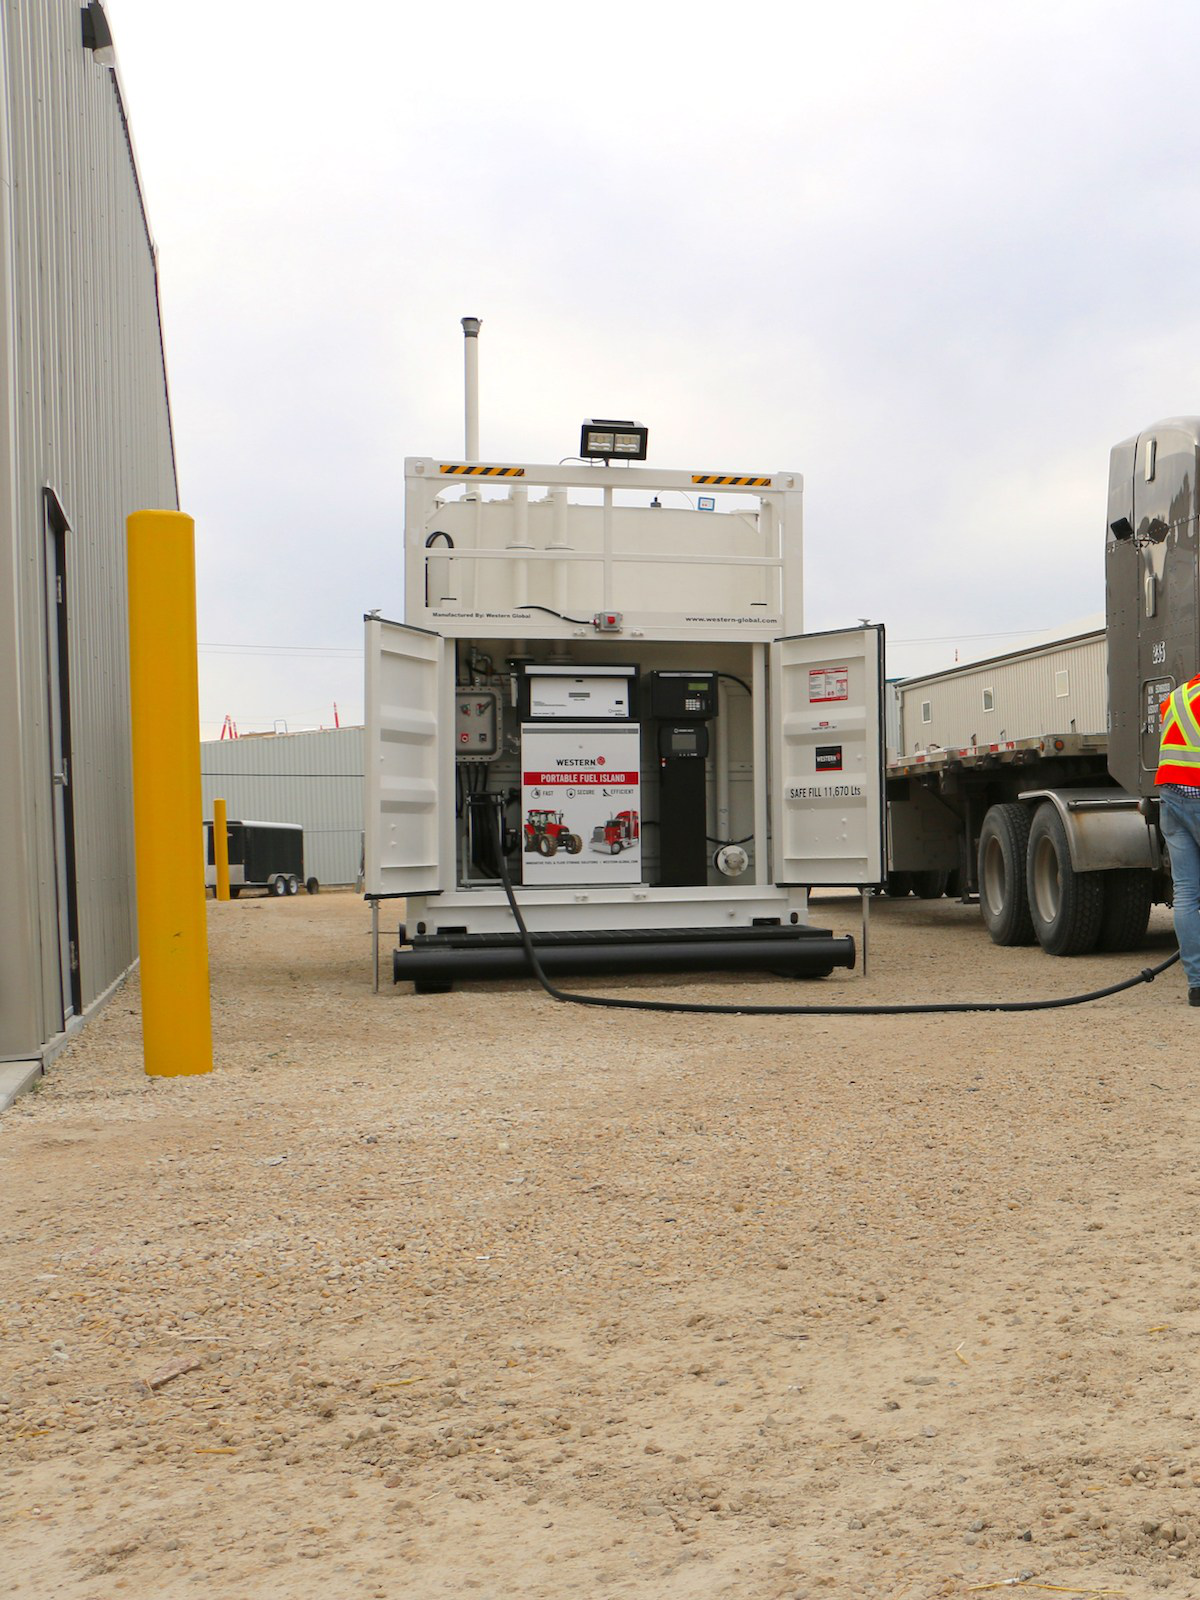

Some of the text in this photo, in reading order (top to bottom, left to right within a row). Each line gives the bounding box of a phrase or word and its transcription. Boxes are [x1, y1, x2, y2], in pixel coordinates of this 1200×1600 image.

[685, 616, 778, 624] www.western-global.com
[540, 774, 626, 783] PORTABLE FUEL ISLAND
[790, 785, 861, 798] SAFE FILL 11,670 Lts
